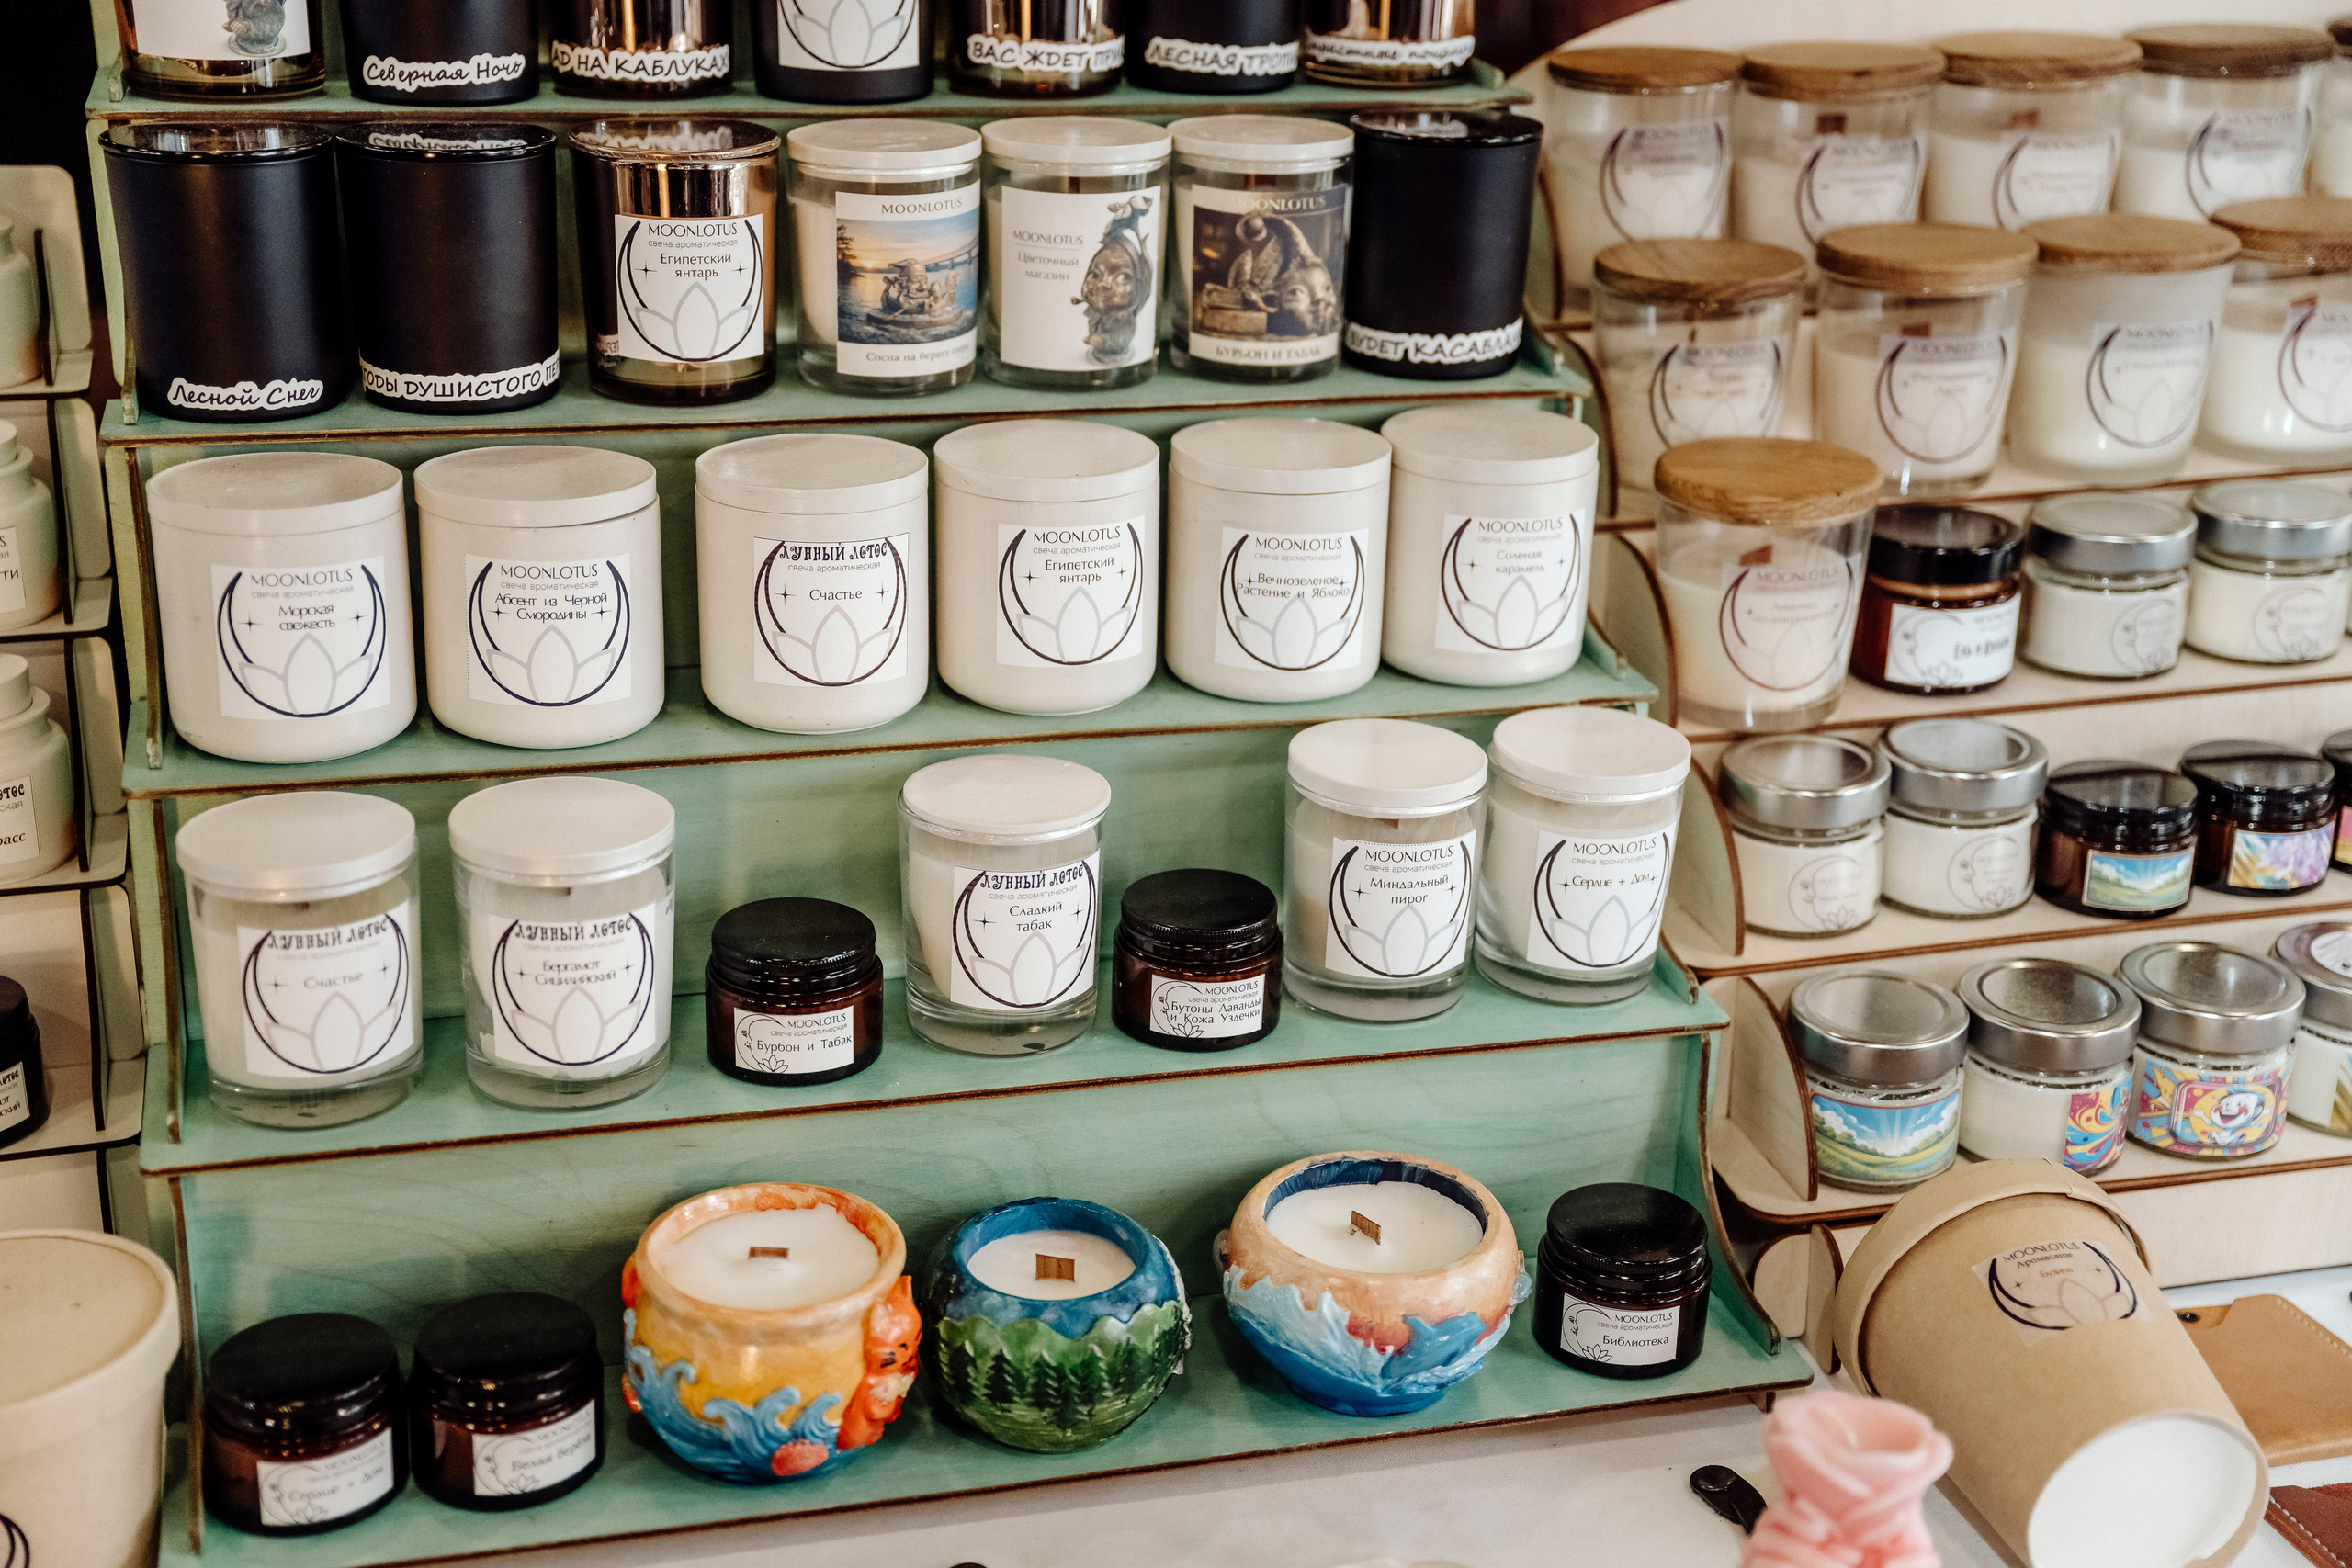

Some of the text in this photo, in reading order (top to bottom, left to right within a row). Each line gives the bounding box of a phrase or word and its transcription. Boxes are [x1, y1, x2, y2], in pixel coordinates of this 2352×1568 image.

[972, 41, 1017, 63] ВАС
[1024, 50, 1088, 67] ЖДЕТ
[1151, 45, 1238, 69] ЛЕСНАЯ
[368, 54, 524, 88] Северная Ночь
[578, 55, 605, 73] НА
[881, 198, 962, 214] MOONLOTUS
[649, 222, 738, 237] MOONLOTUS
[676, 240, 738, 249] ароматическая
[1012, 230, 1083, 245] MOONLOTUS
[661, 253, 731, 265] Египетский
[1018, 252, 1079, 266] Цветочный
[675, 268, 718, 280] янтарь
[1024, 269, 1069, 280] магазин
[865, 352, 899, 362] Сосна
[903, 353, 916, 361] на
[404, 370, 540, 398] ДУШИСТОГО
[173, 378, 320, 406] Лесной Снег
[1478, 517, 1563, 533] MOONLOTUS
[1034, 526, 1121, 543] MOONLOTUS
[1505, 533, 1562, 544] ароматическая
[1061, 543, 1121, 555] ароматическая
[1255, 537, 1342, 551] MOONLOTUS
[780, 543, 888, 561] ЛУННЫЙ ЛОТОС
[1282, 554, 1341, 562] ароматическая
[1497, 549, 1542, 560] Соленая
[817, 561, 880, 572] ароматическая
[1046, 557, 1114, 570] Египетский
[1496, 565, 1544, 576] карамель
[251, 569, 353, 587] MOONLOTUS
[501, 564, 598, 579] MOONLOTUS
[1059, 572, 1101, 585] янтарь
[501, 581, 598, 591] свеча ароматическая
[1258, 573, 1339, 586] Вечнозеленое
[283, 586, 354, 599] ароматическая
[809, 589, 863, 601] Счастье
[1236, 583, 1290, 598] Растение
[1312, 587, 1350, 598] Яблоко
[495, 592, 607, 608] Абсент из Черной
[279, 605, 334, 619] Морская
[516, 608, 586, 623] Смородины
[279, 619, 335, 630] свежесть
[1573, 837, 1657, 855] MOONLOTUS
[1365, 845, 1453, 863] MOONLOTUS
[1599, 853, 1655, 865] ароматическая
[1364, 861, 1452, 874] свеча ароматическая
[980, 864, 1084, 890] ЛУННЫЙ ЛОТОС
[1370, 875, 1448, 889] Миндальный
[1572, 875, 1612, 889] Сердце
[1017, 885, 1077, 900] ароматическая
[1391, 895, 1429, 907] пирог
[1010, 902, 1062, 917] Сладкий
[514, 918, 632, 941] ЛУННЫЙ ЛОТОС
[1016, 919, 1052, 931] табак
[267, 919, 387, 950] ЛУННЫЙ ЛОТОС
[542, 961, 601, 974] Бергамот
[304, 972, 363, 989] Счастье
[1205, 981, 1258, 995] MOONLOTUS
[1211, 991, 1259, 1004] ароматическая
[1171, 998, 1261, 1014] Бутоны Лаванды
[788, 1013, 846, 1029] MOONLOTUS
[1184, 1013, 1214, 1024] Кожа
[1220, 1010, 1260, 1022] Уздечки
[794, 1024, 847, 1037] ароматическая
[757, 1040, 799, 1054] Бурбон
[821, 1035, 852, 1049] Табак
[2003, 1242, 2080, 1263] MOONLOTUS
[1615, 1313, 1672, 1323] MOONLOTUS
[1597, 1322, 1672, 1331] свеча ароматическая
[1603, 1336, 1668, 1347] Библиотека
